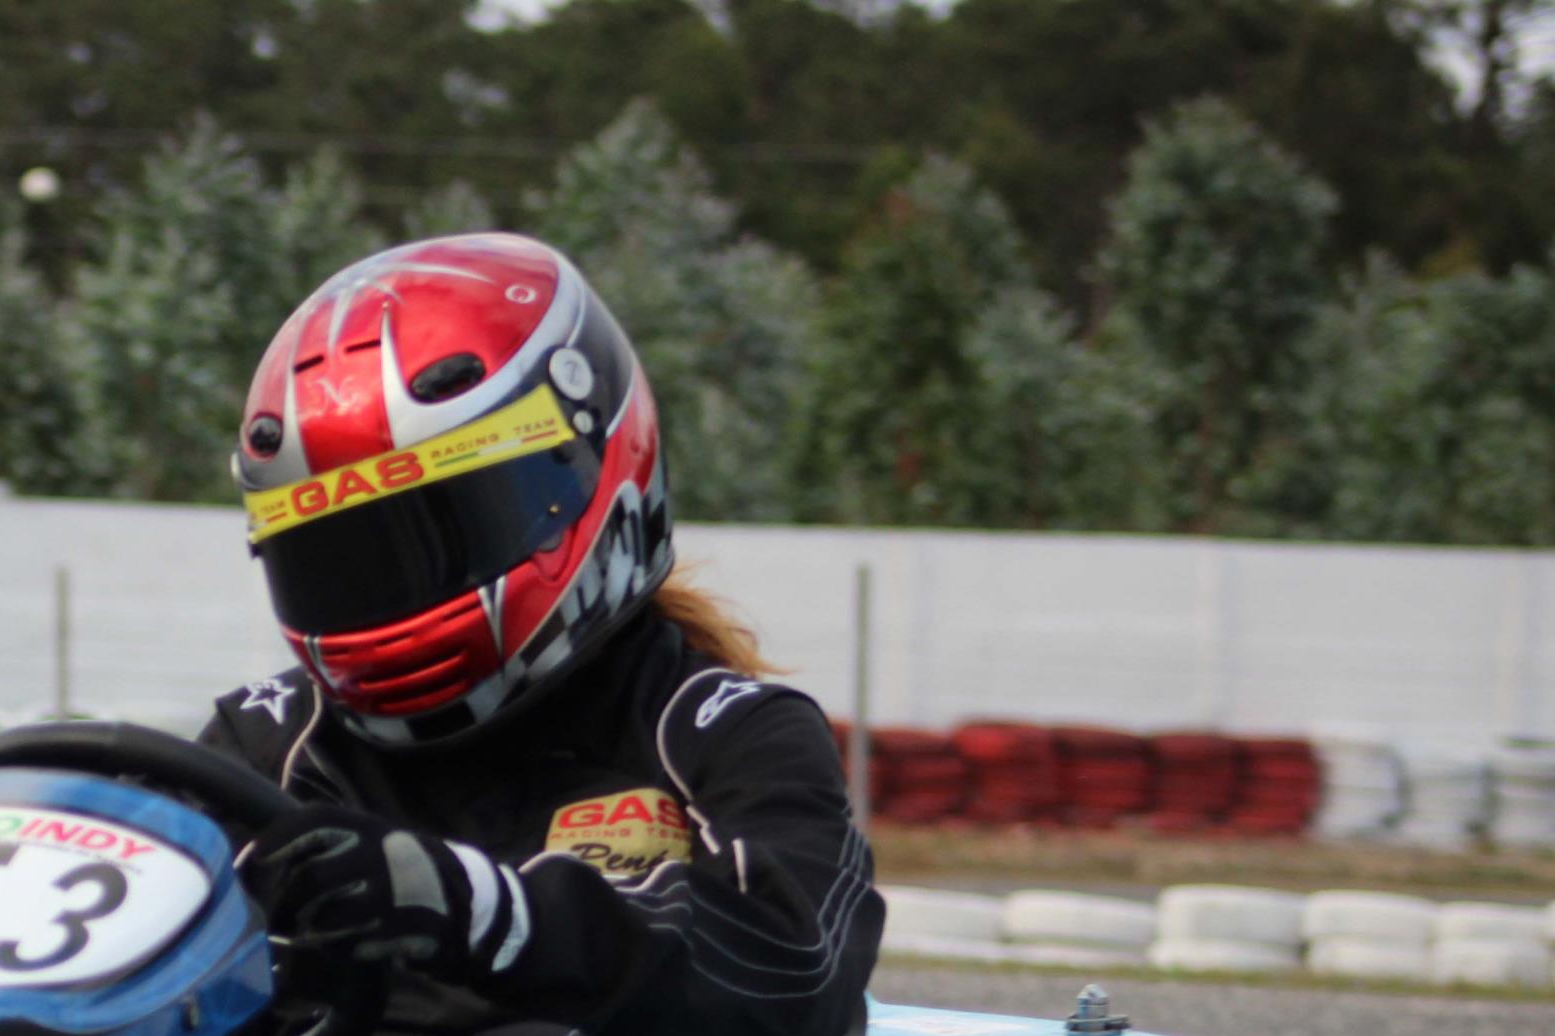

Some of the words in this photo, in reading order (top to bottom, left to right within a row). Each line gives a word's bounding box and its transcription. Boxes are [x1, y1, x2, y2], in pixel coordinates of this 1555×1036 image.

[291, 451, 425, 517] GAS
[430, 431, 501, 461] RACING
[513, 417, 556, 437] TEAM
[558, 796, 687, 829] GAS
